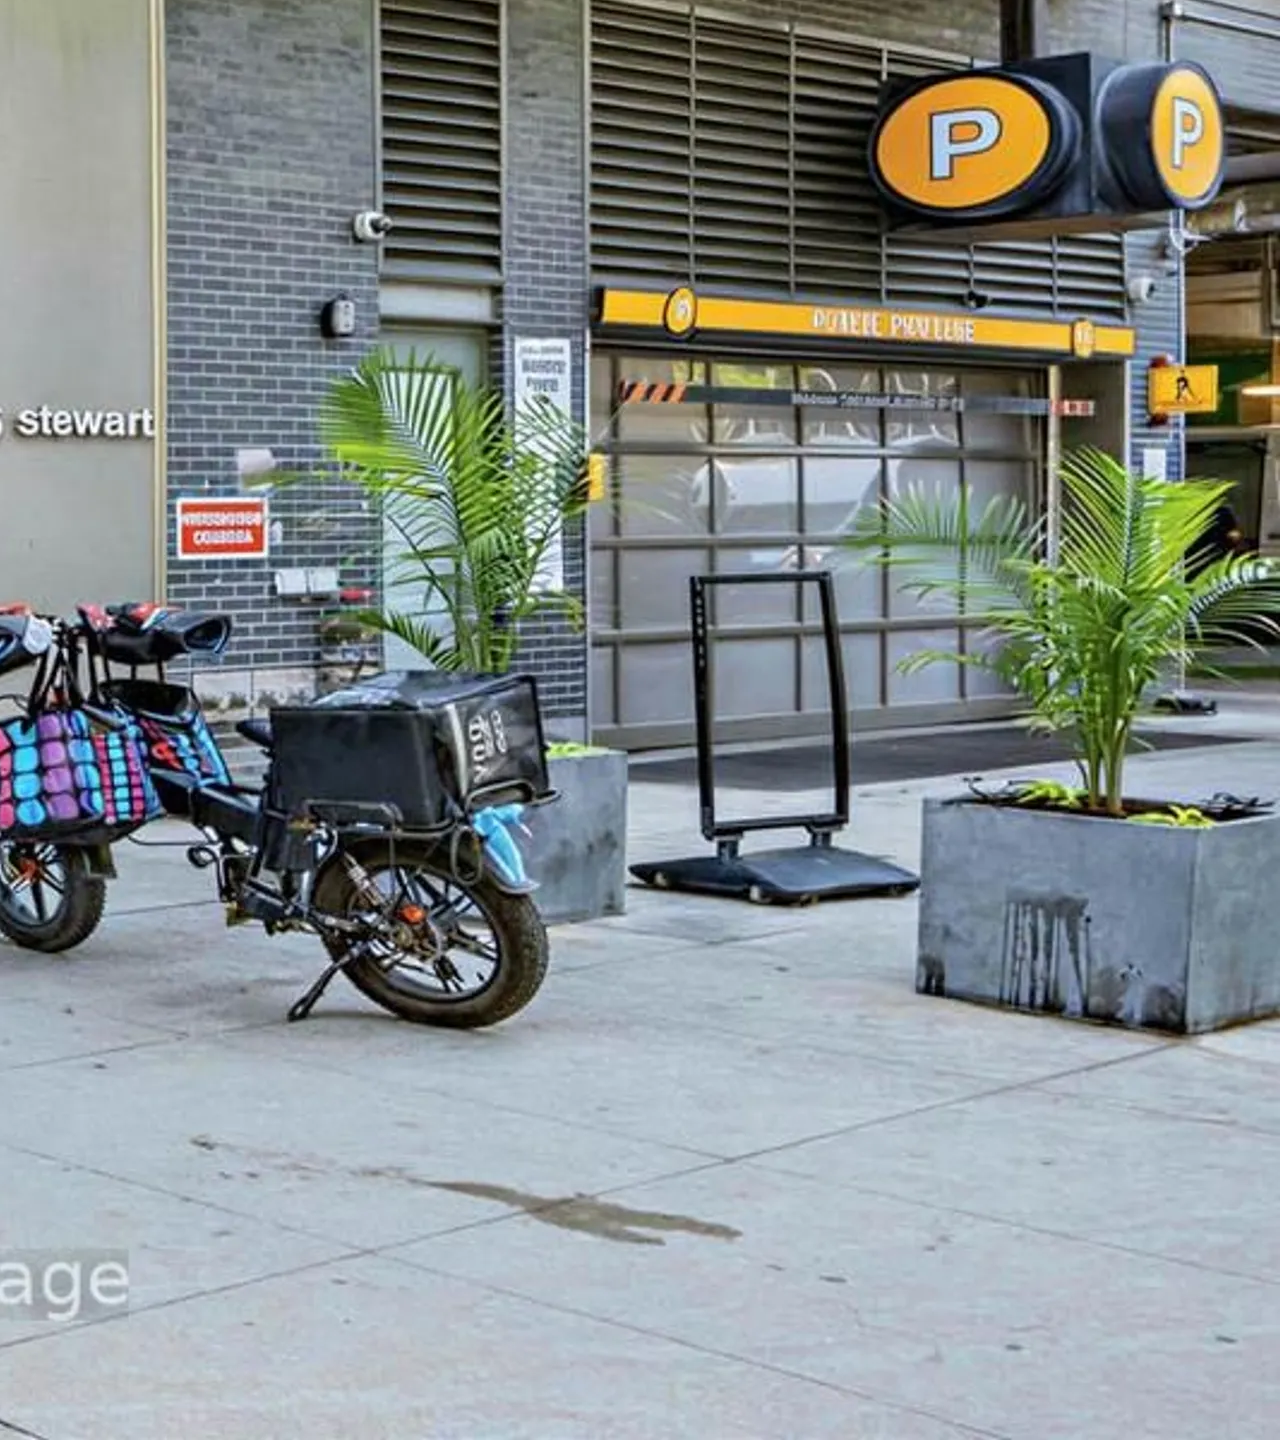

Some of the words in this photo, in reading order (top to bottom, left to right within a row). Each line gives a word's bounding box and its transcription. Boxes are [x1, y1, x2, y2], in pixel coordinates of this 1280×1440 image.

[929, 107, 1003, 181] P
[1171, 96, 1204, 169] P
[18, 404, 155, 437] stewart
